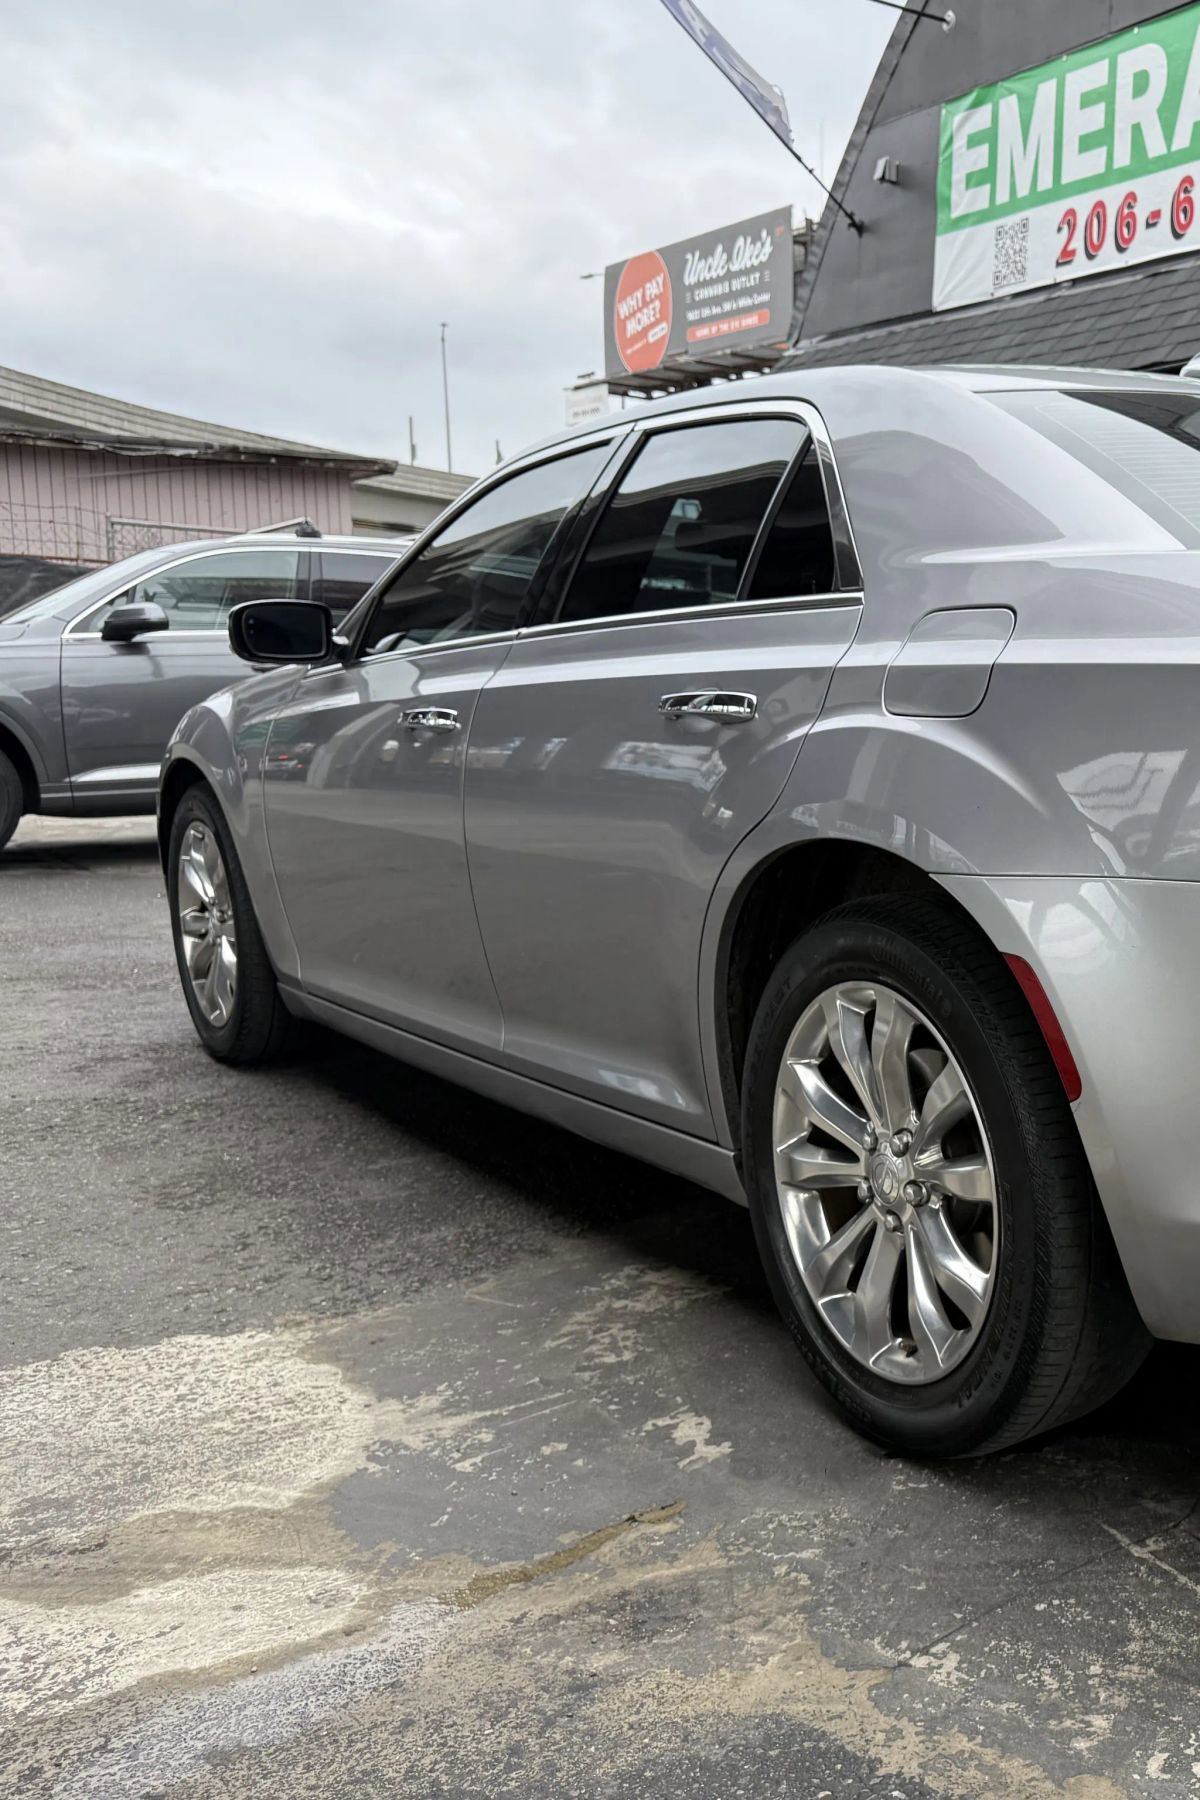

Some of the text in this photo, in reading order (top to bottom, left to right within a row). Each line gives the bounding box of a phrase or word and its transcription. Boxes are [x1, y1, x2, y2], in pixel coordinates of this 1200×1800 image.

[683, 228, 774, 286] Uncle Ike's
[618, 272, 664, 320] WHY PAY
[730, 271, 760, 291] OUTLET
[626, 299, 661, 338] MORE?
